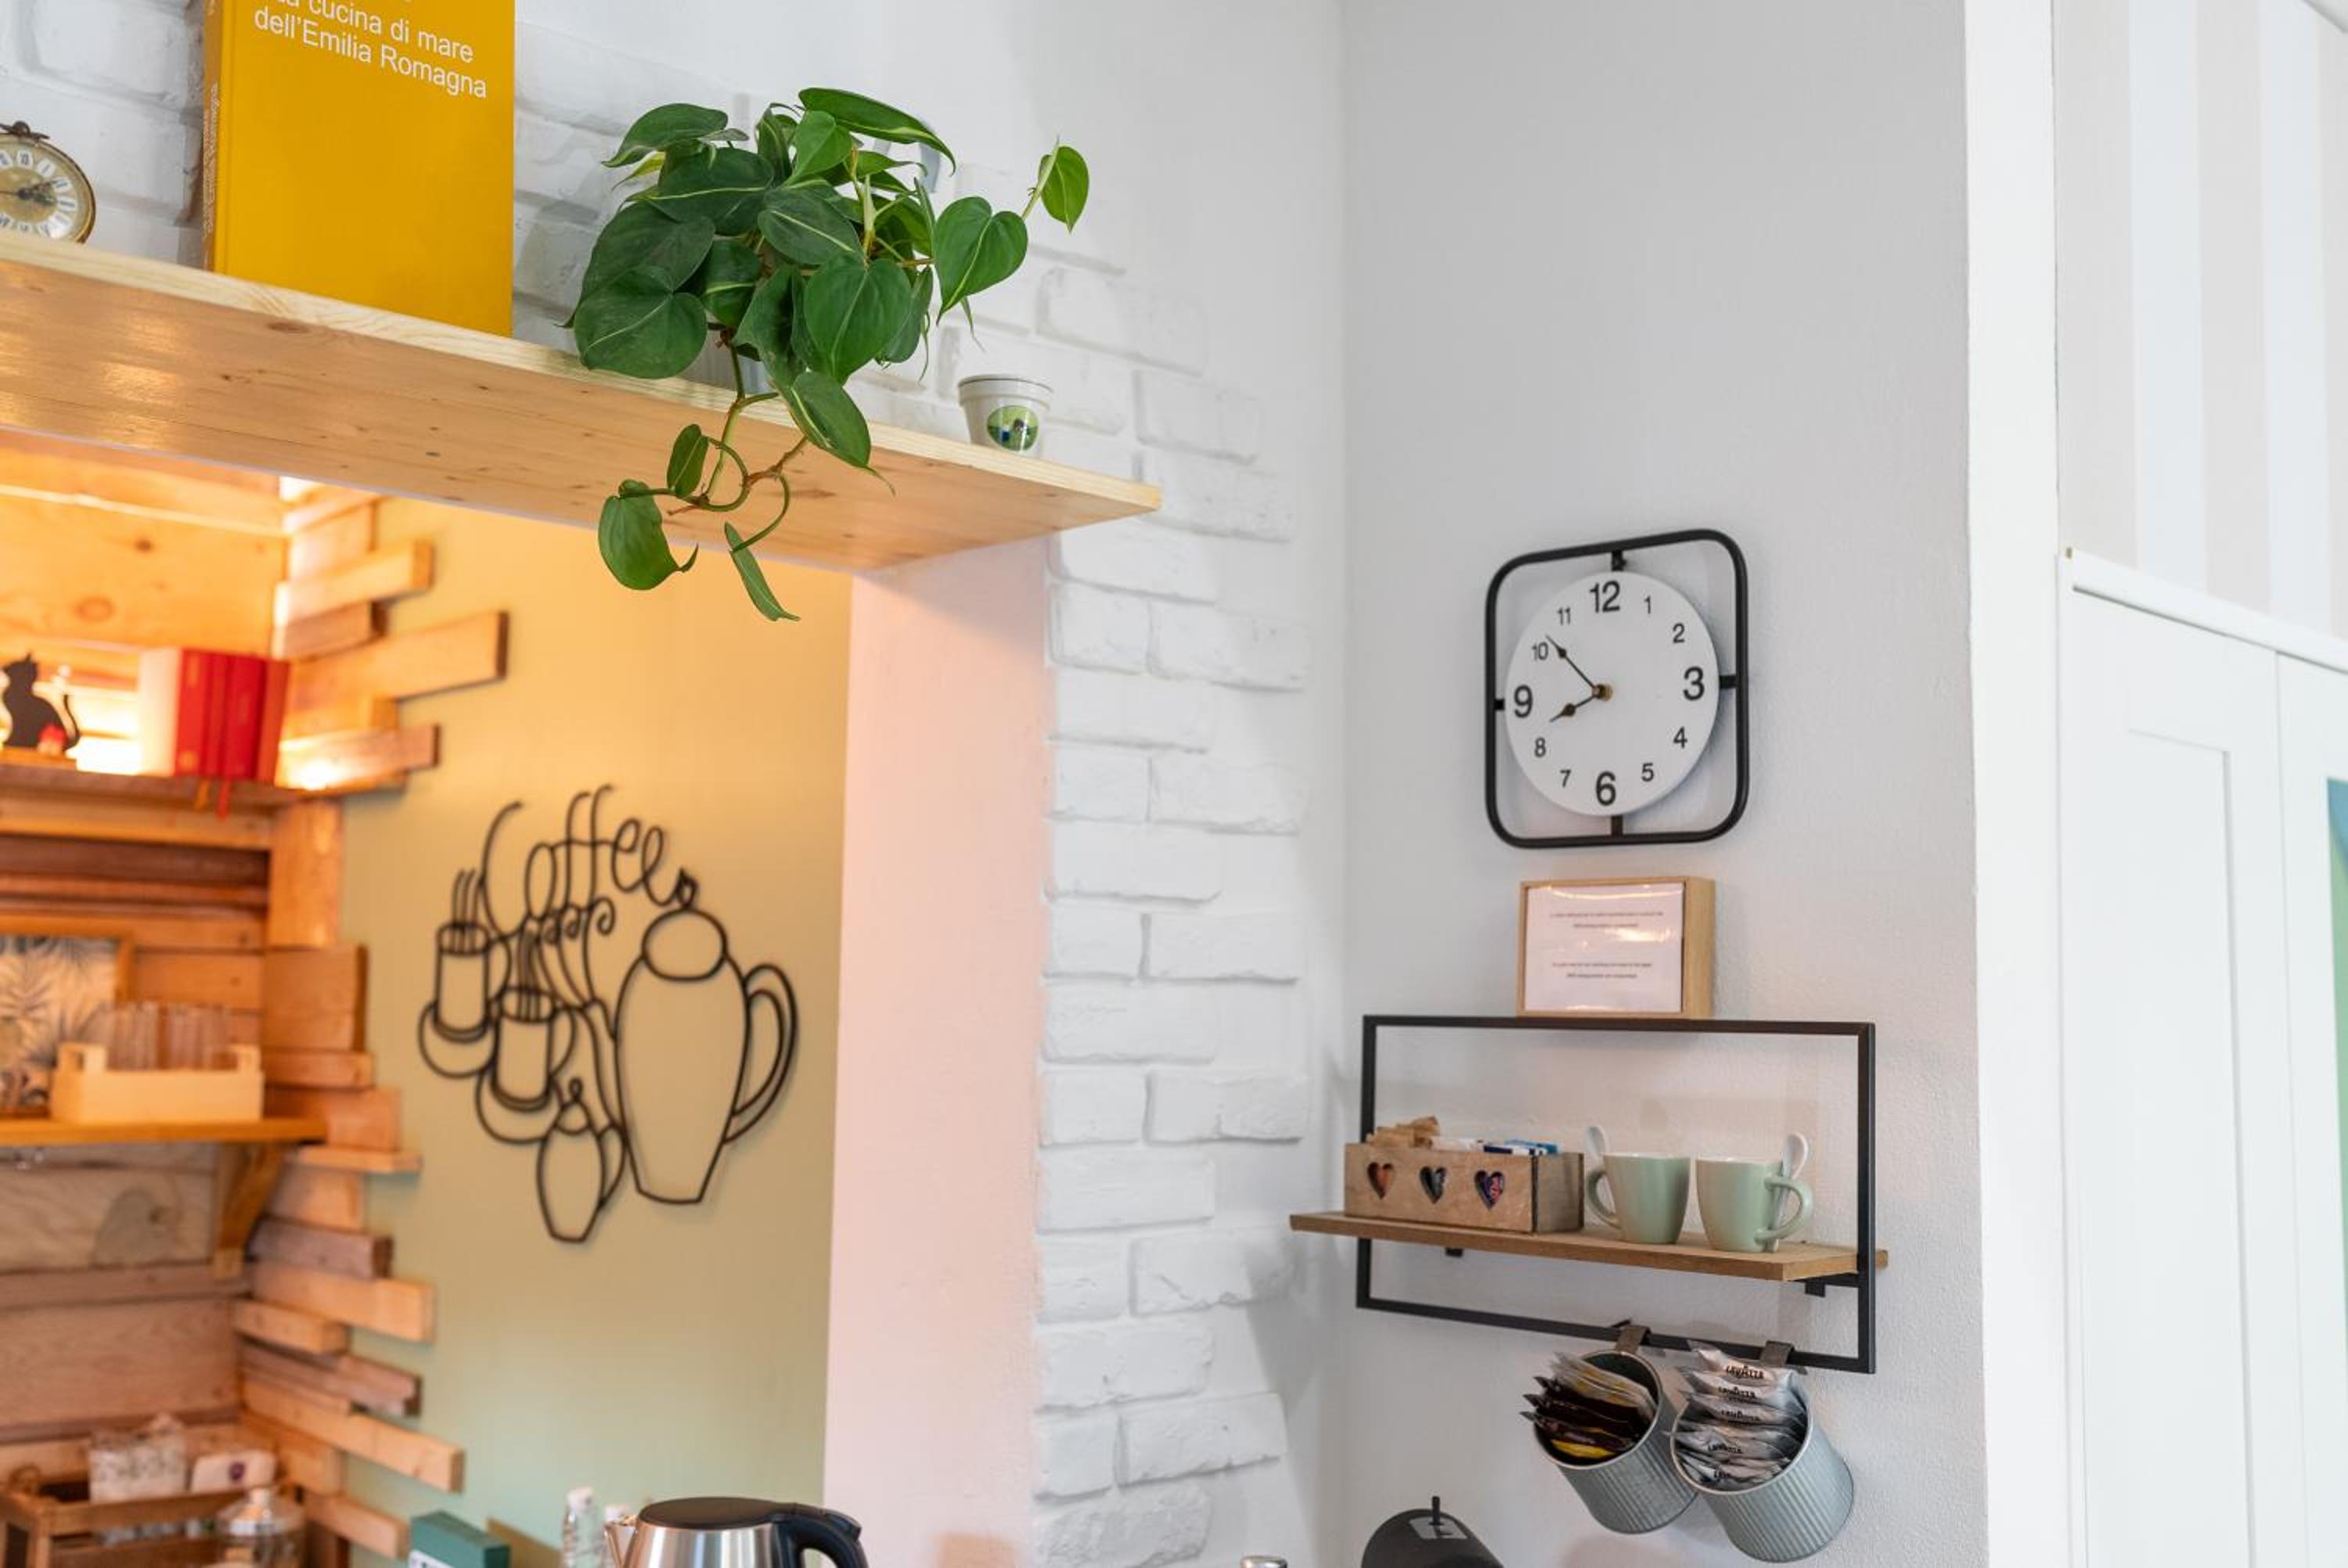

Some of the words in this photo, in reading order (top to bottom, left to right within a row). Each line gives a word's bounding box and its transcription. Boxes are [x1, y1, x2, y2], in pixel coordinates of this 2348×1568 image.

[308, 0, 382, 34] cucina
[391, 18, 409, 43] di
[418, 30, 474, 63] mare
[380, 43, 487, 99] Romagna
[1590, 580, 1621, 614] 12
[1644, 595, 1651, 614] 1
[1557, 606, 1572, 626] 11
[1672, 622, 1685, 644] 2
[1532, 642, 1549, 661] 10
[1682, 666, 1705, 702] 3
[1513, 684, 1534, 719] 9
[1534, 736, 1547, 758] 8
[1673, 725, 1688, 750] 4
[1559, 768, 1572, 788] 7
[1641, 762, 1655, 782] 5
[1594, 770, 1617, 807] 6
